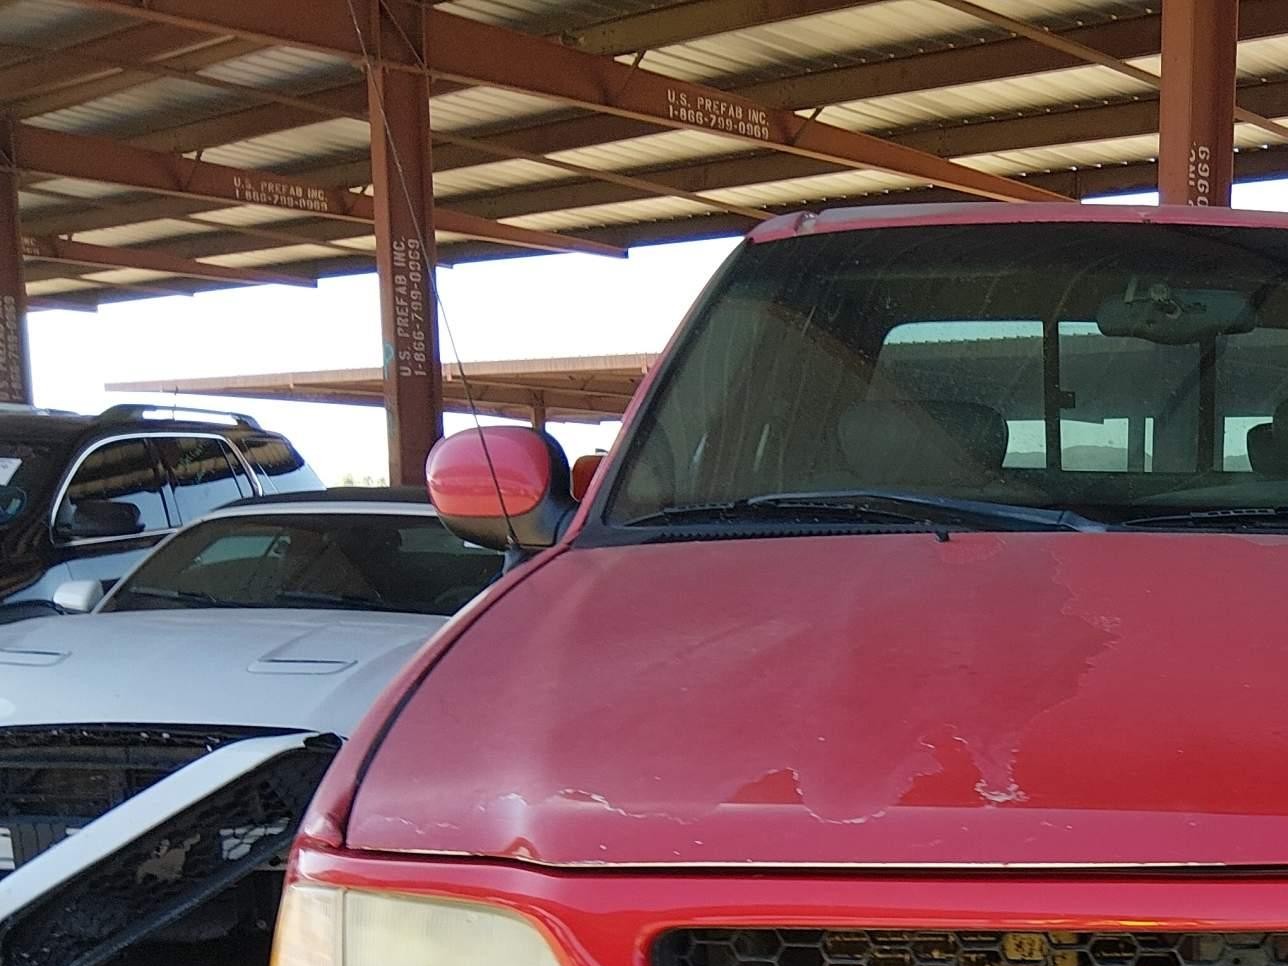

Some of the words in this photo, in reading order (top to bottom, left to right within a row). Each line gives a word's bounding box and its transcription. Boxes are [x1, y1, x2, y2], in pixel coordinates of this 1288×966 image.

[667, 89, 691, 108] U.S.
[697, 97, 743, 120] PREFAB
[748, 109, 770, 126] INC.
[668, 104, 770, 140] 1-866-799-0969
[392, 236, 407, 267] INC.
[394, 274, 410, 338] PREFAB
[408, 238, 427, 376] 1-866-799-0969
[399, 346, 412, 377] U.S.
